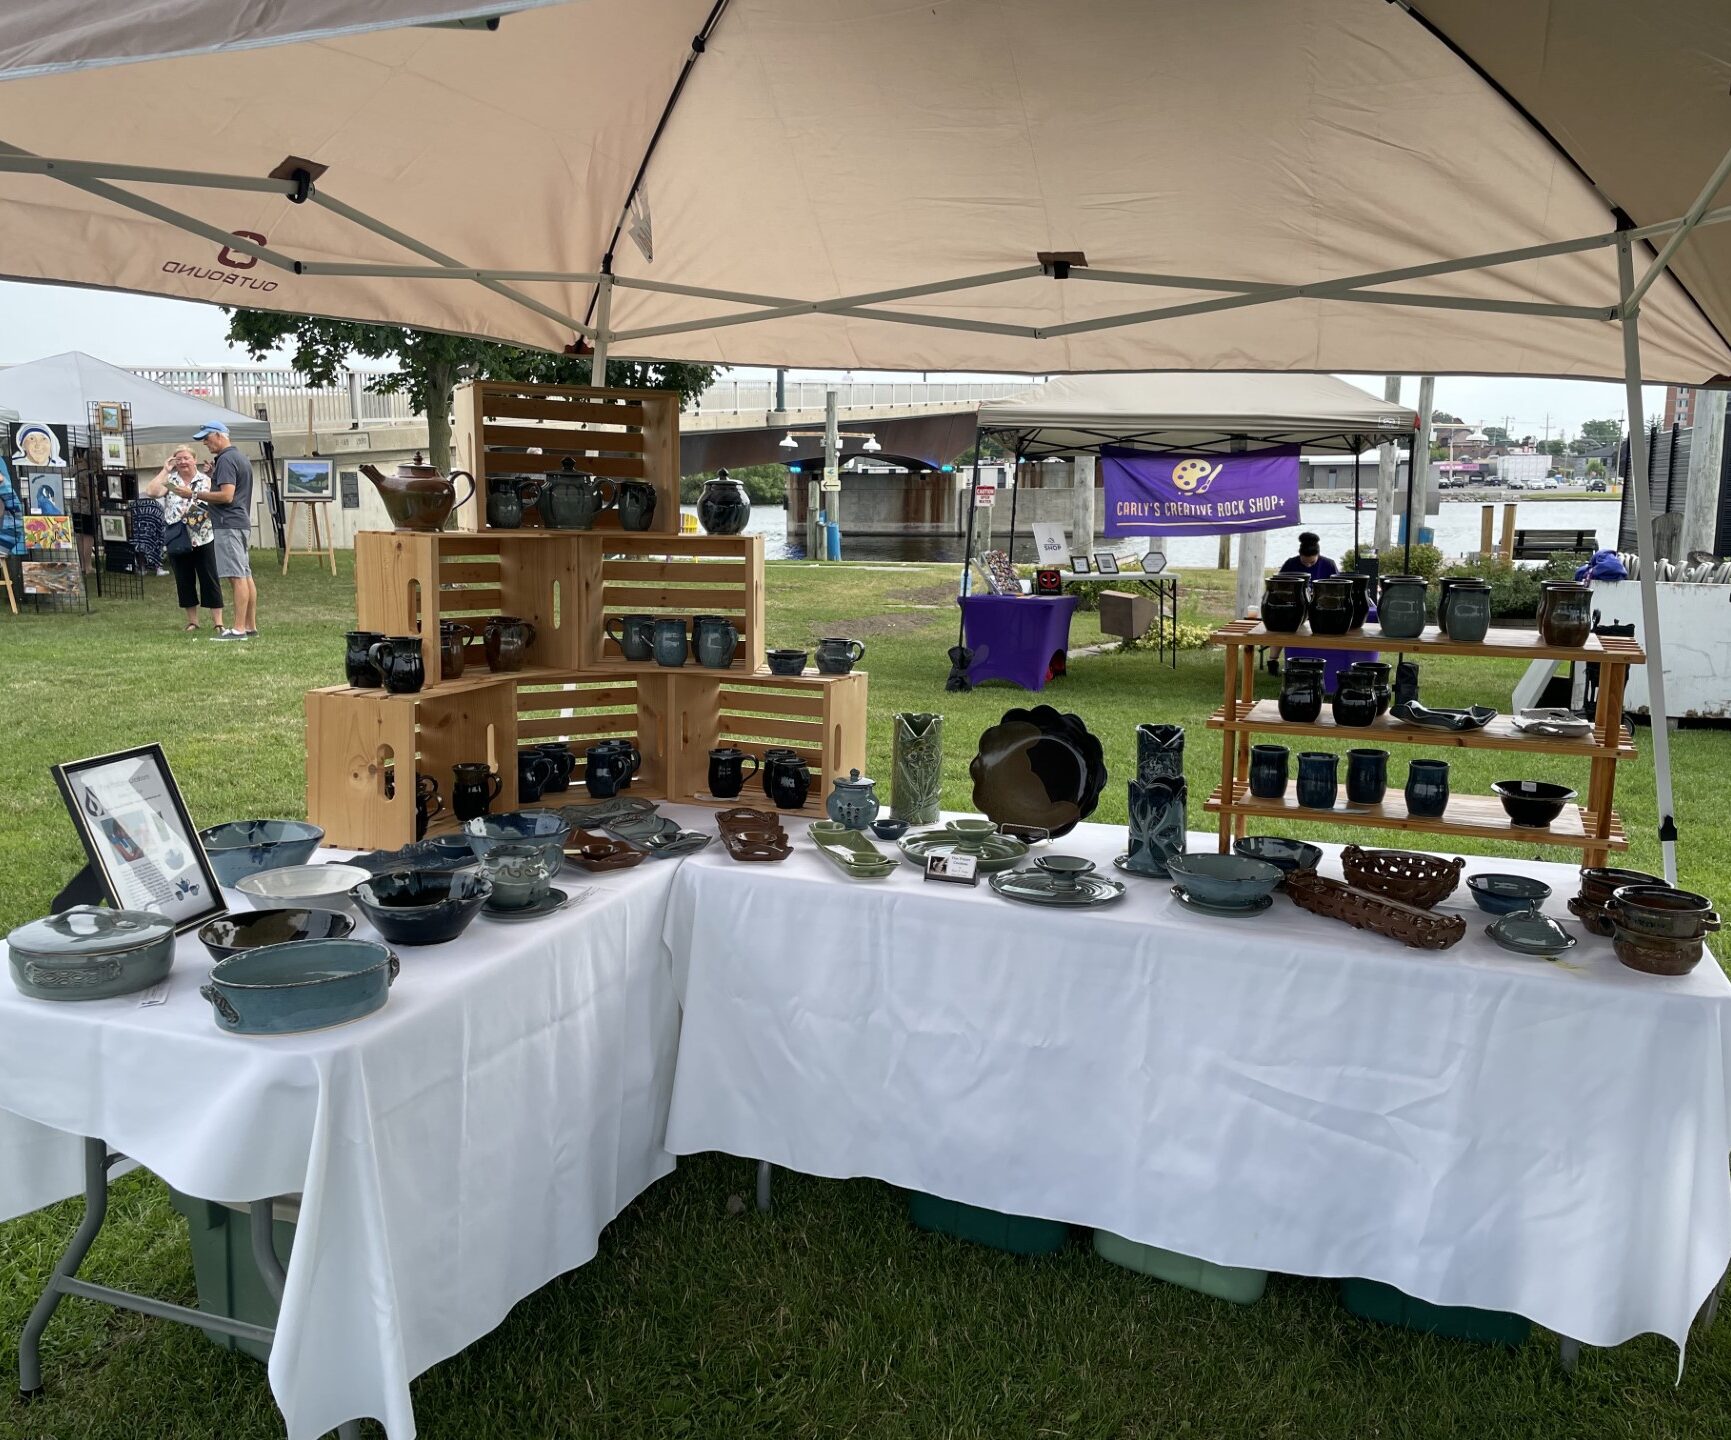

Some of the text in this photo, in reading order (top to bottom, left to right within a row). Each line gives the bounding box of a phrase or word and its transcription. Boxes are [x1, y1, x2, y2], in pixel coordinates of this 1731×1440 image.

[1116, 501, 1161, 517] CARLY'S
[1164, 501, 1213, 517] CREATIVE
[1217, 499, 1245, 517] ROCK
